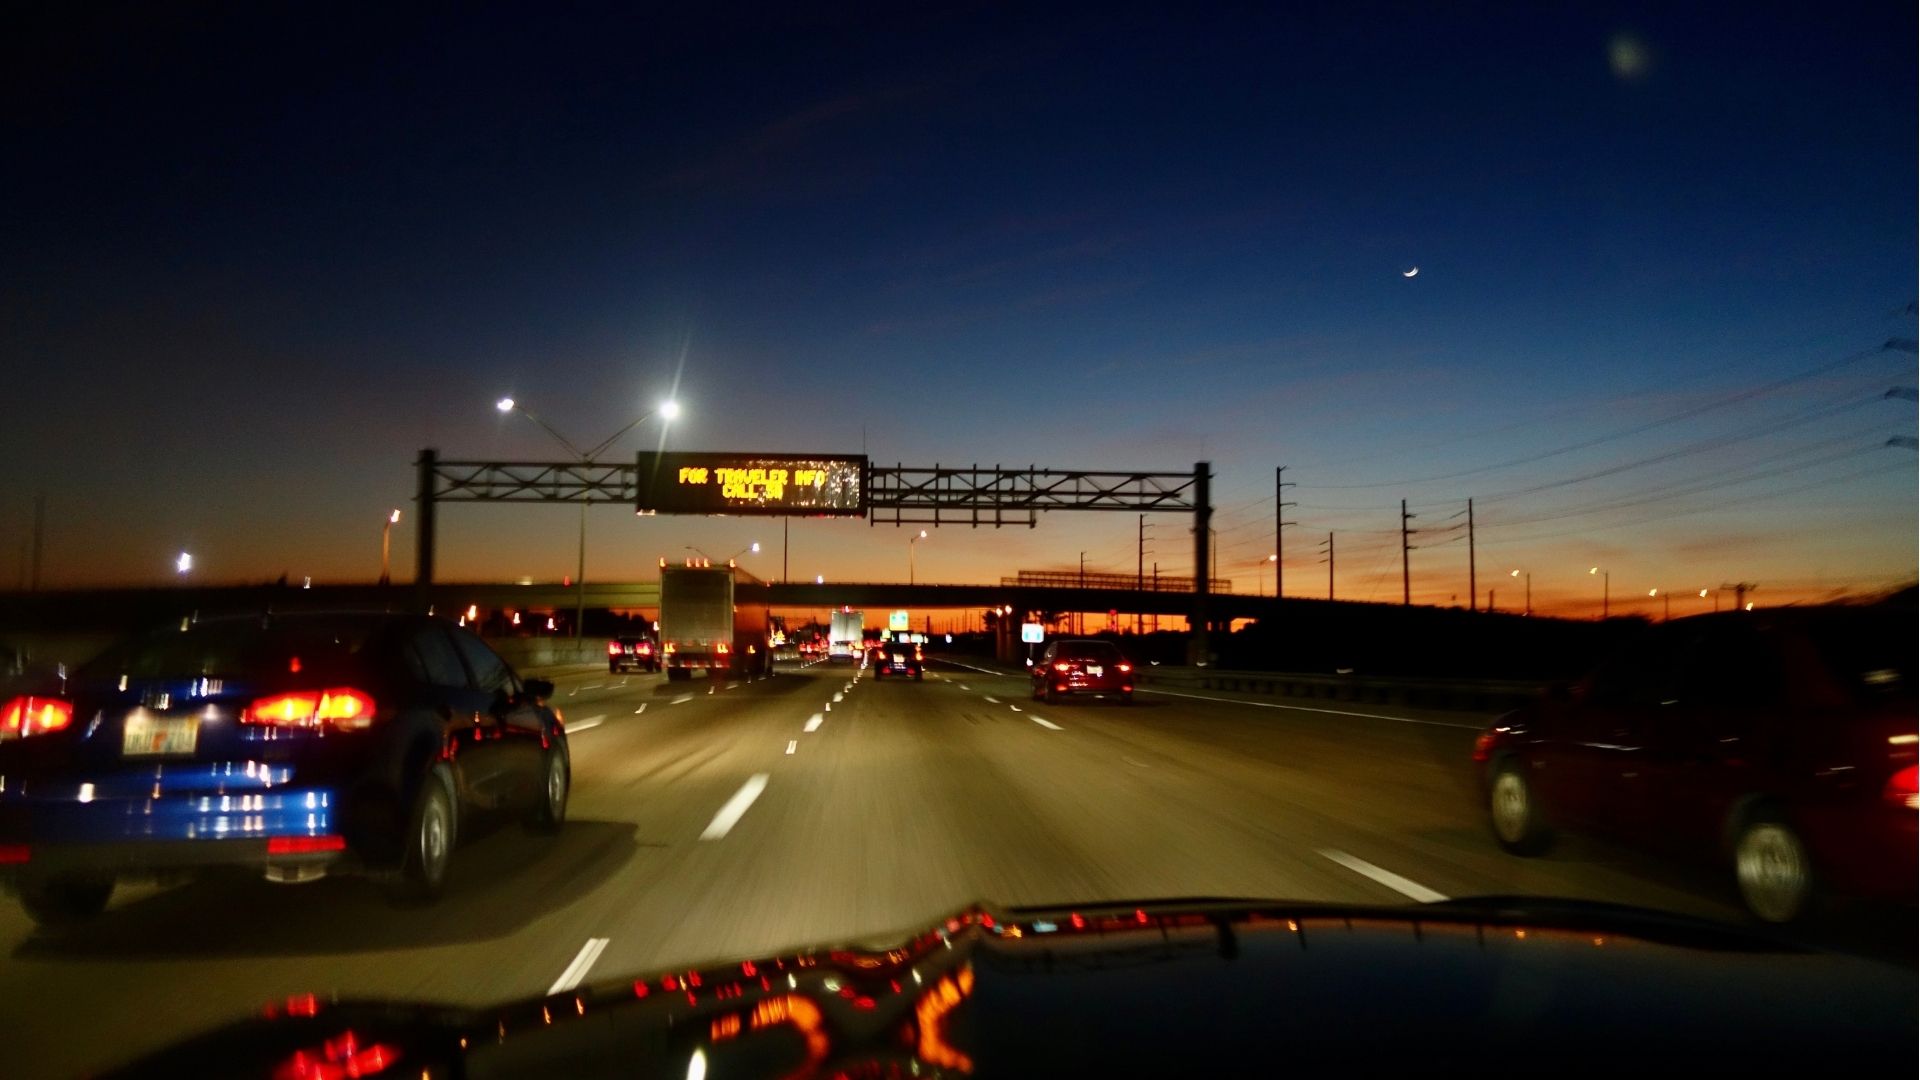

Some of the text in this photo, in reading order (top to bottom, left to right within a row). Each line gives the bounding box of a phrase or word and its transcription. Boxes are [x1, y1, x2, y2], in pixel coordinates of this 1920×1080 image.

[679, 467, 826, 486] FOR TRAVELER INFO
[722, 483, 758, 499] CALL
